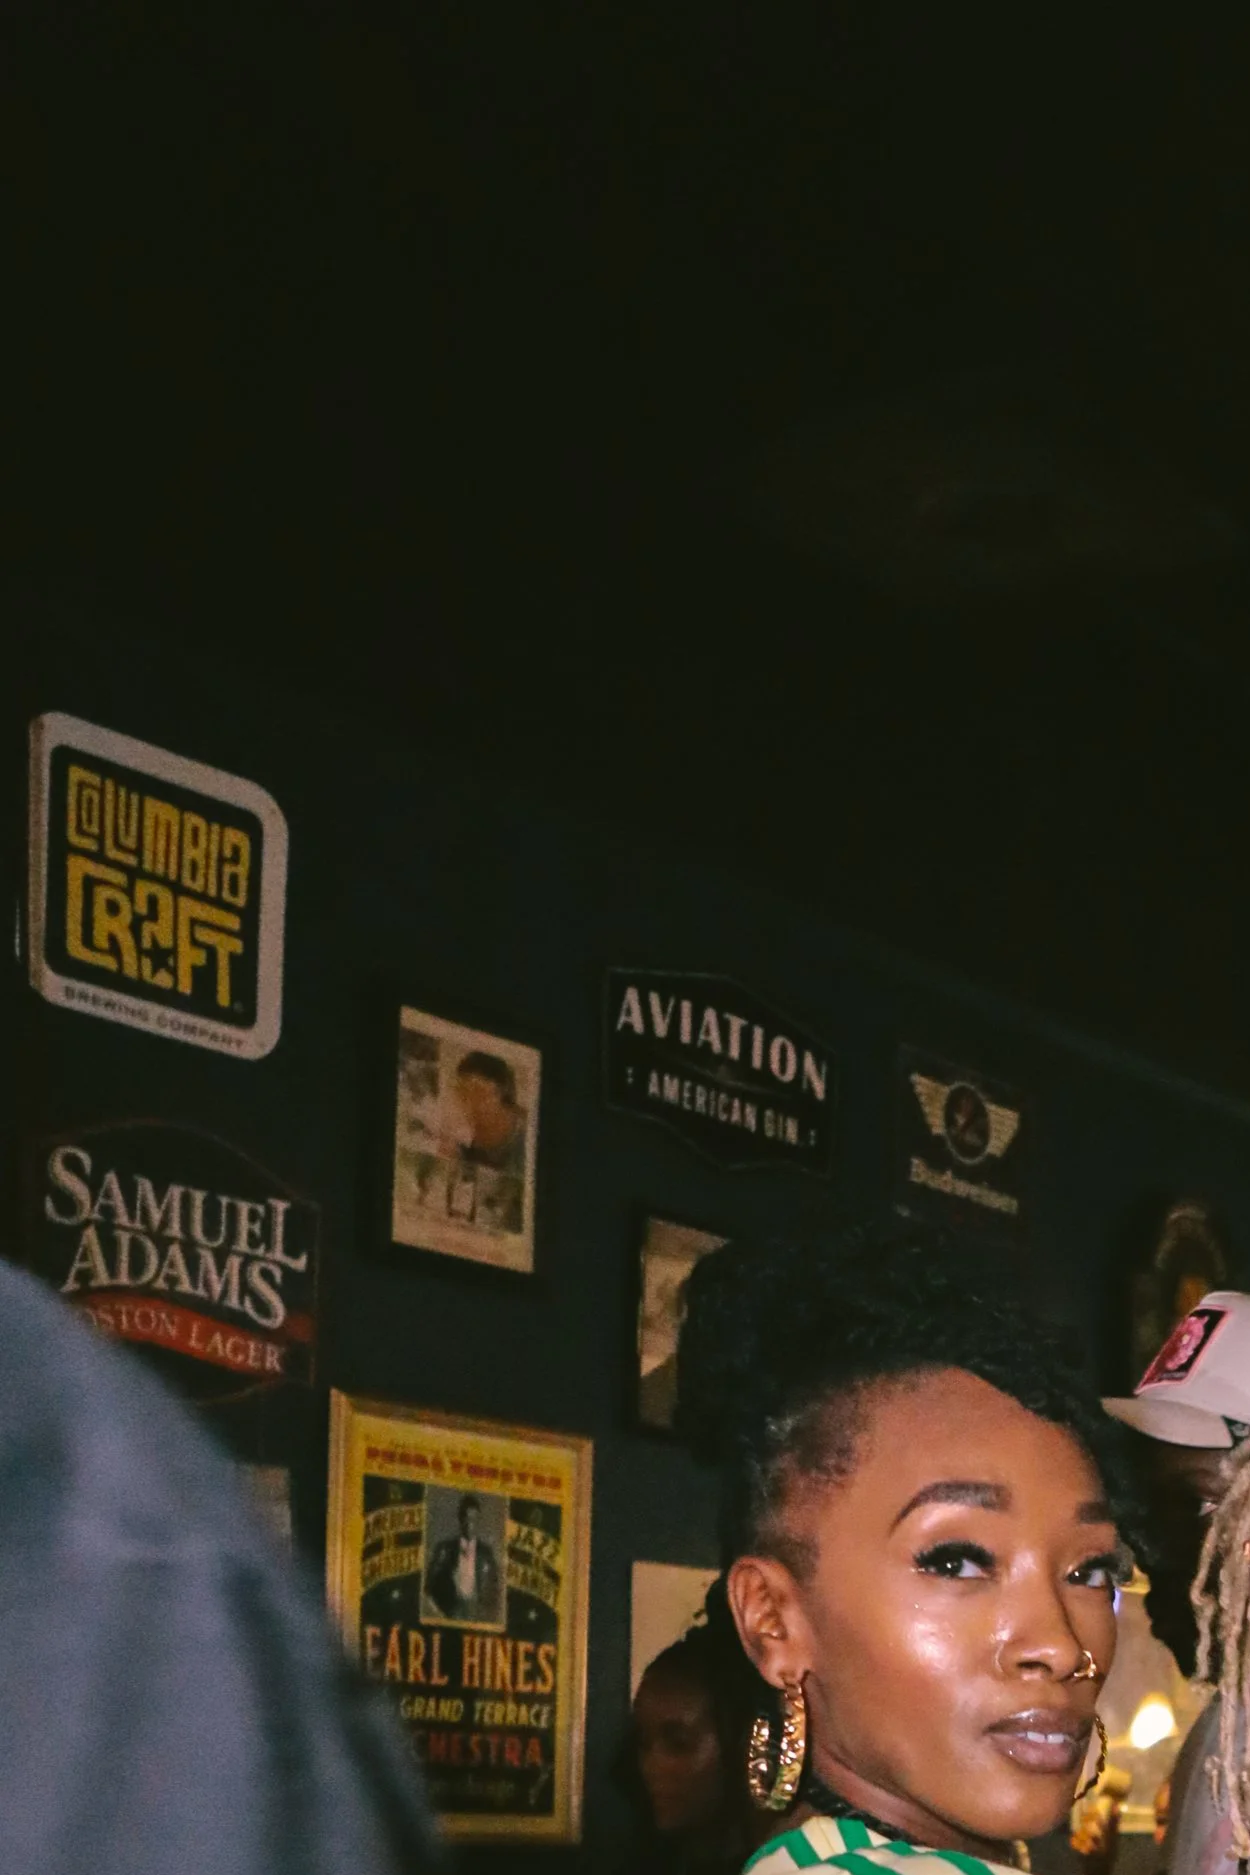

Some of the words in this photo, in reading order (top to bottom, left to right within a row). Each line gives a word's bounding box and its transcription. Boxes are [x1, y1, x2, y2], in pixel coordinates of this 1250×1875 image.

[66, 853, 244, 1008] CRAFT
[155, 1012, 244, 1049] COMPANY
[616, 986, 827, 1101] AVIATION
[647, 1069, 758, 1134] AMERICAN
[763, 1108, 800, 1146] GIN
[45, 1145, 308, 1273] SAMUEL
[60, 1224, 288, 1330] ADAMS
[85, 1304, 177, 1341] STON
[187, 1322, 286, 1374] LAGER
[514, 1522, 562, 1564] JAZZ
[365, 1623, 450, 1688] EARL
[461, 1632, 556, 1694] HINES
[400, 1694, 465, 1723] GRAND
[473, 1698, 550, 1729] TERRACE
